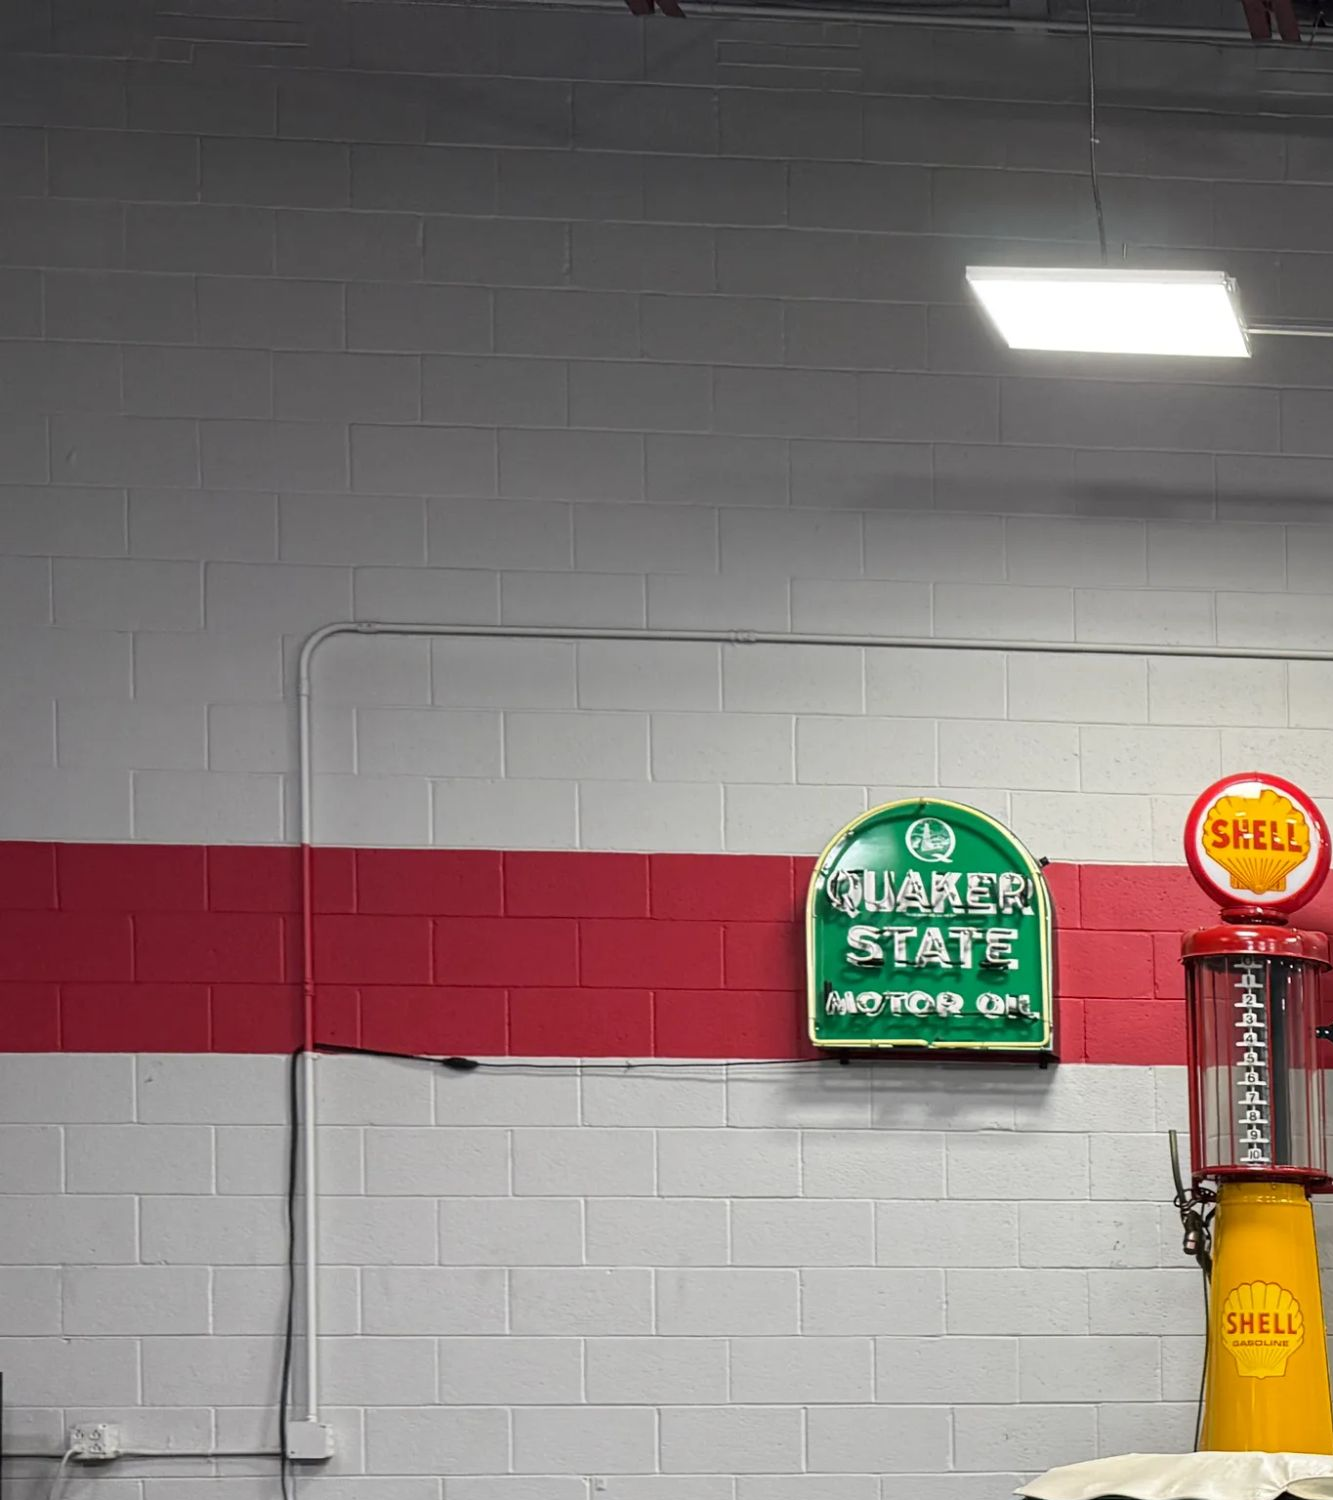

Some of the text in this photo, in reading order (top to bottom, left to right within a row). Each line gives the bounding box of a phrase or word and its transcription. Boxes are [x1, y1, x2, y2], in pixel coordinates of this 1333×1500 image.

[1211, 819, 1303, 853] SHELL
[826, 869, 1036, 918] QUAKER
[846, 926, 1020, 970] STATE
[1245, 994, 1254, 1005] 2
[825, 990, 1041, 1022] MOTOR OIL
[1246, 1014, 1254, 1024] 3
[1245, 1034, 1254, 1043] 4
[1246, 1053, 1255, 1064] 5
[1247, 1072, 1256, 1083] 6
[1248, 1092, 1256, 1102] 7
[1249, 1111, 1257, 1121] 8
[1250, 1130, 1258, 1140] 9
[1249, 1150, 1260, 1160] 10
[1227, 1312, 1297, 1335] SHELL
